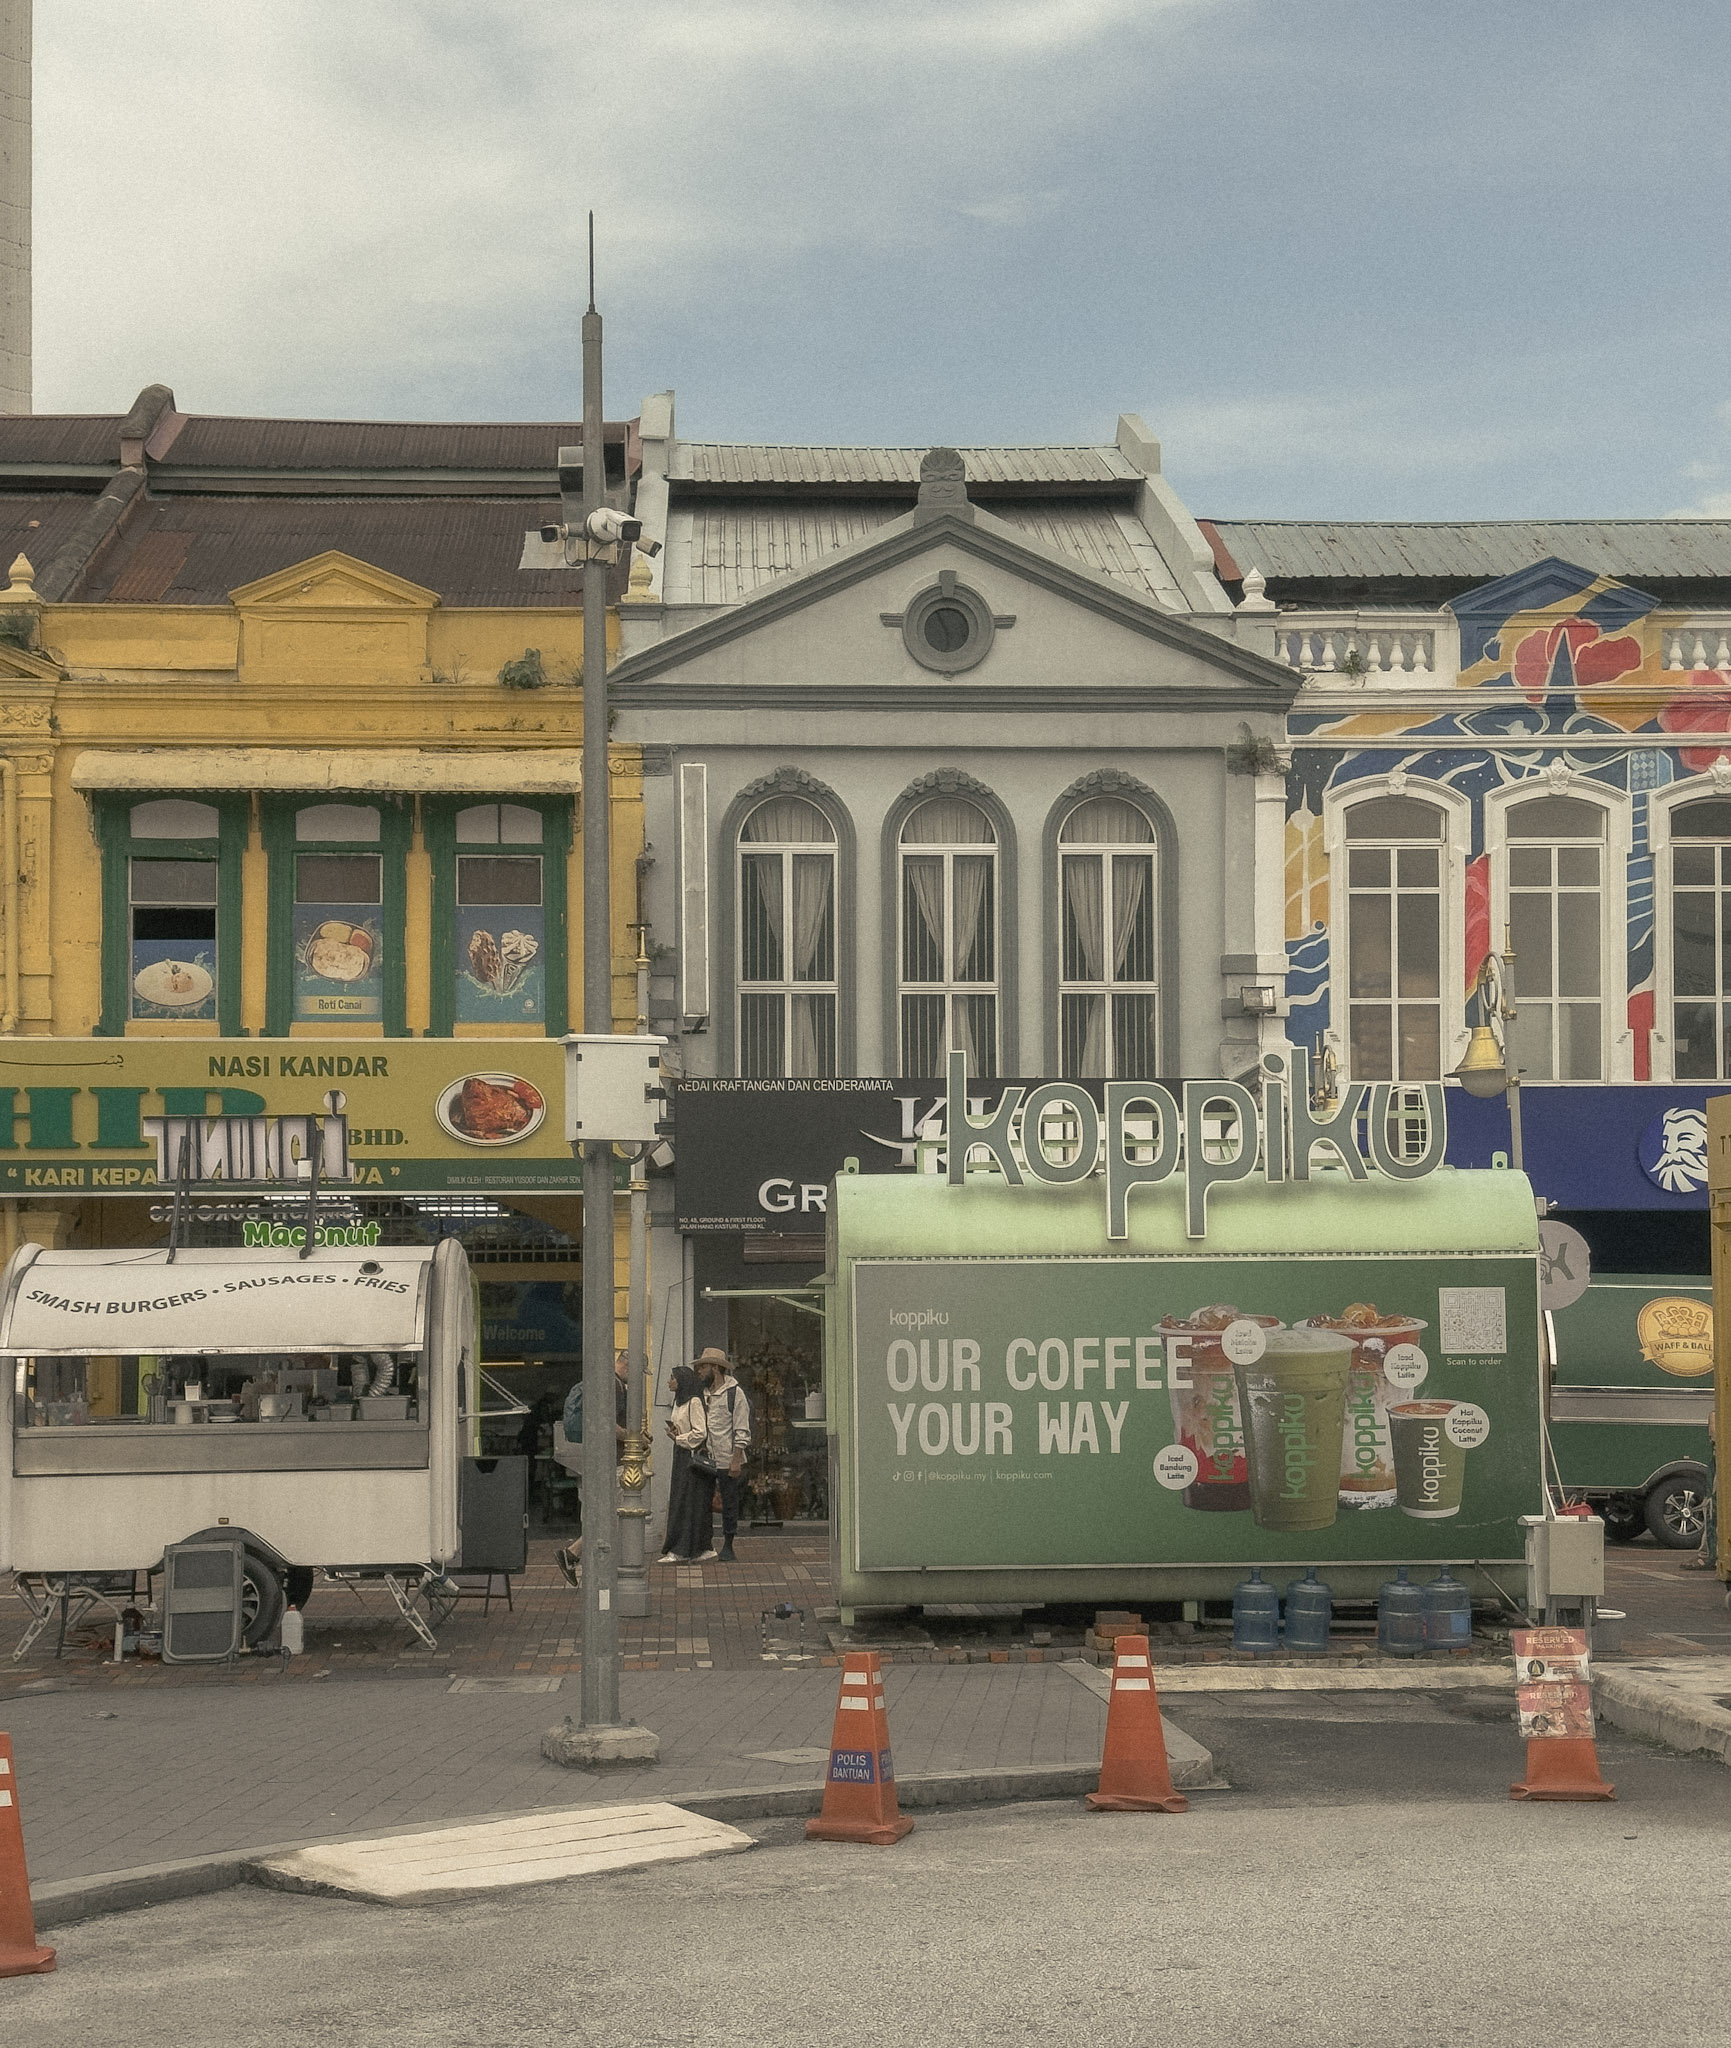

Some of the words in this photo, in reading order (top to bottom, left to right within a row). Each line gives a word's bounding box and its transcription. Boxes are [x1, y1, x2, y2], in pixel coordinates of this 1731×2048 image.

[318, 999, 336, 1010] Roti
[338, 999, 362, 1010] Canai
[209, 1056, 270, 1077] NASI
[280, 1056, 389, 1077] KANDAR
[677, 1080, 710, 1092] KEDAI
[713, 1080, 785, 1092] KRAFTANGAN
[788, 1080, 810, 1092] DAN
[813, 1080, 894, 1092] CENDERAMATA
[947, 1046, 1448, 1240] koppiku
[25, 1168, 84, 1186] KARI
[485, 1176, 514, 1184] RESTORAN
[26, 1289, 100, 1314] SMASH
[106, 1288, 208, 1314] BURGERS
[223, 1274, 336, 1293] SAUSAGES
[353, 1275, 411, 1295] FRIES
[889, 1308, 949, 1331] koppiku
[483, 1324, 545, 1341] Welcome
[1655, 1342, 1681, 1351] WAFF
[886, 1338, 981, 1392] OUR
[1005, 1336, 1194, 1391] COFFEE
[1446, 1357, 1465, 1366] Scan
[1468, 1357, 1477, 1366] to
[1479, 1357, 1502, 1366] order
[886, 1402, 1013, 1456] YOUR
[1038, 1400, 1130, 1454] WAY
[1205, 1375, 1244, 1480] koppiku
[1348, 1375, 1386, 1479] koppiku
[1277, 1393, 1317, 1499] koppiku
[1160, 1464, 1192, 1473] Bandung
[1417, 1426, 1447, 1503] koppiku
[837, 1754, 866, 1766] POLIS
[832, 1767, 870, 1780] BANTUAN
